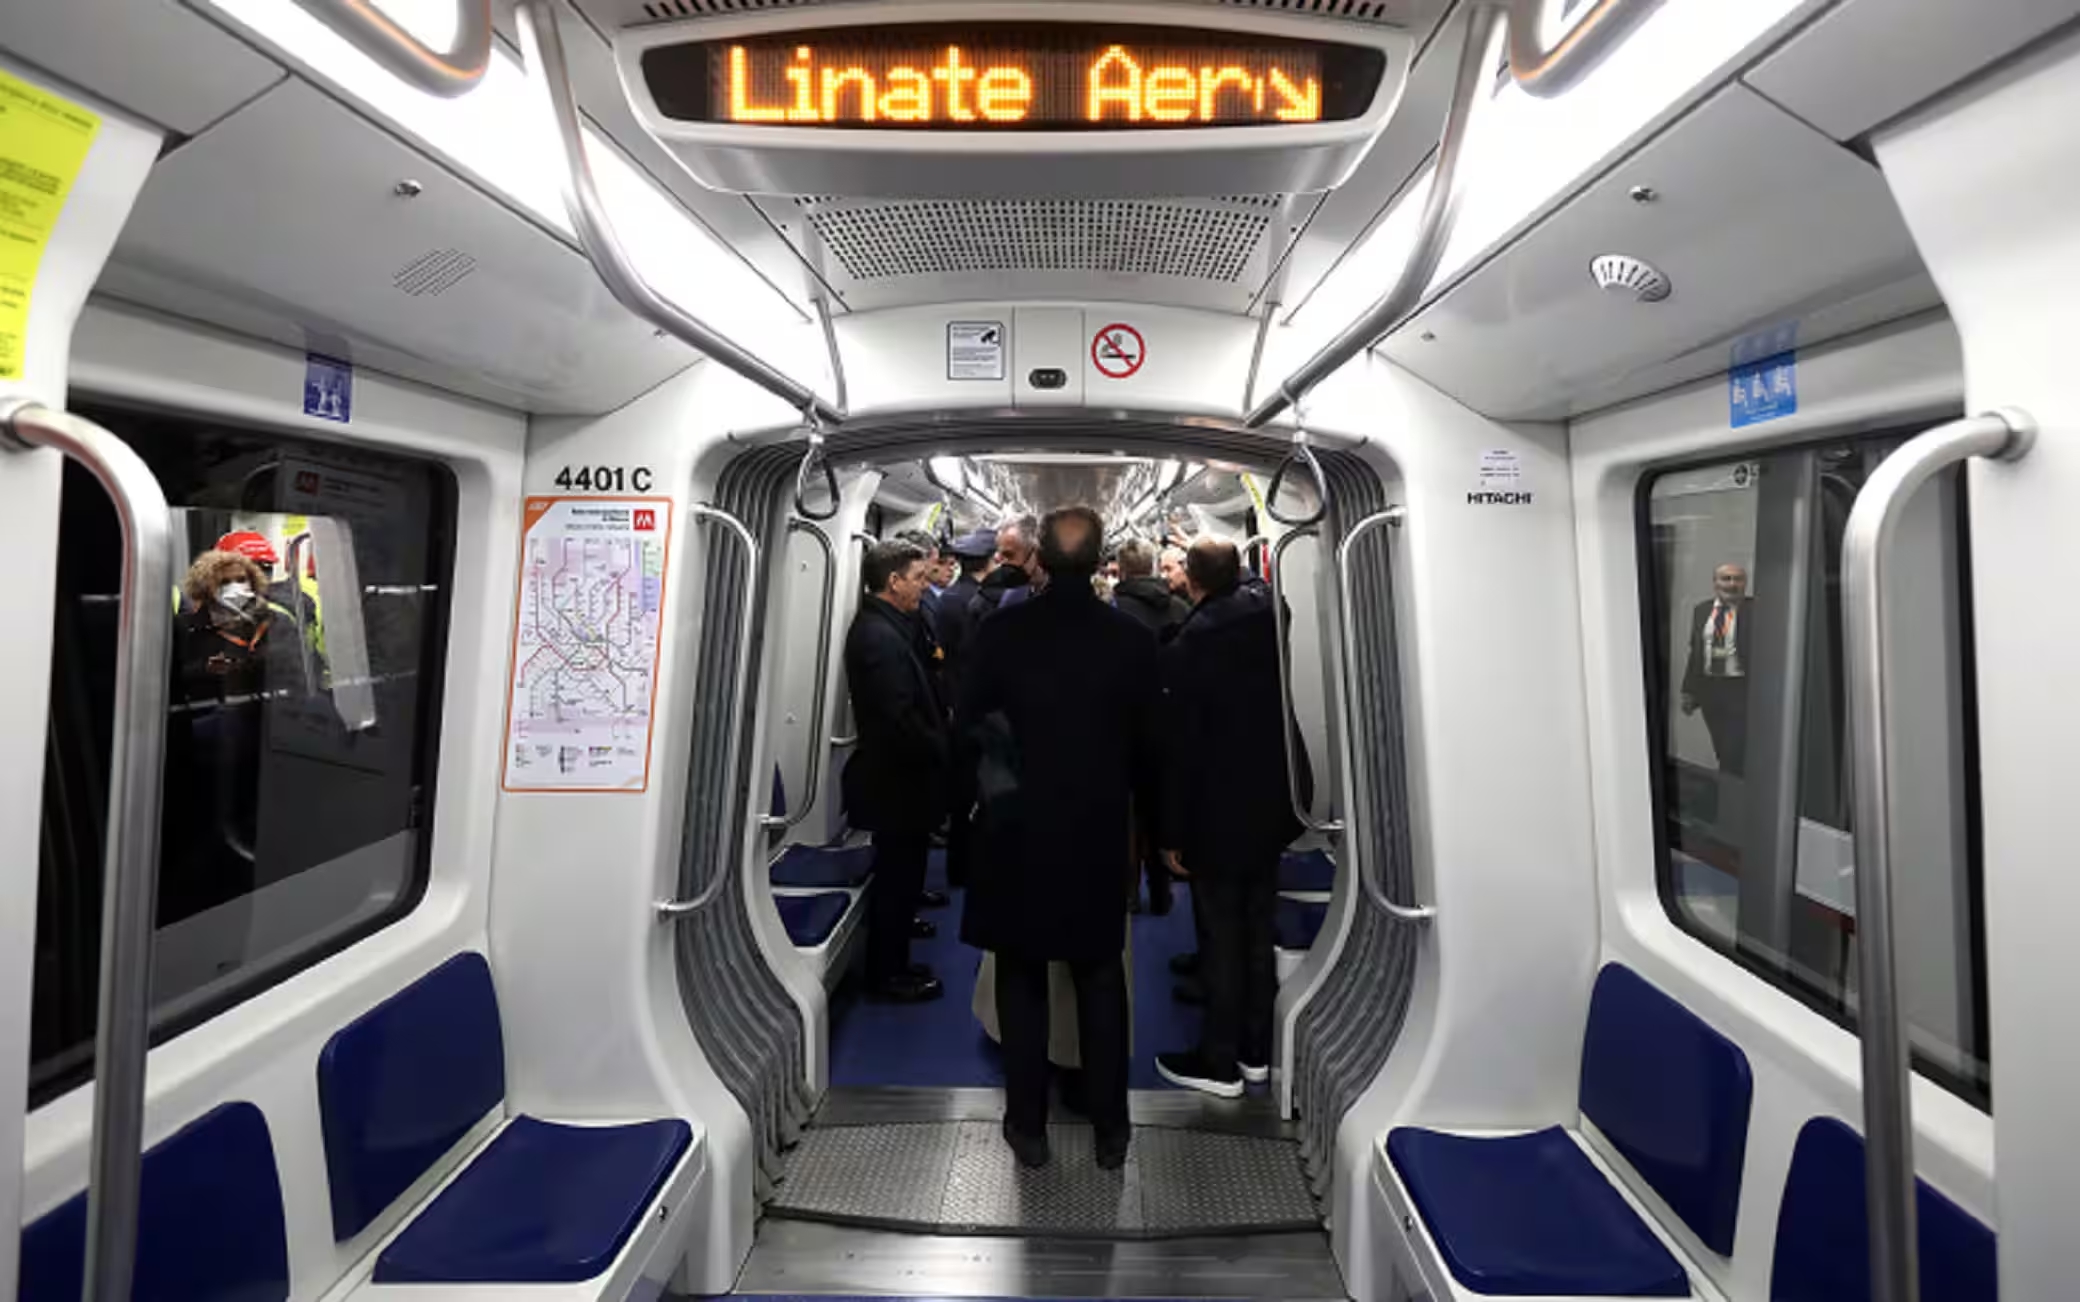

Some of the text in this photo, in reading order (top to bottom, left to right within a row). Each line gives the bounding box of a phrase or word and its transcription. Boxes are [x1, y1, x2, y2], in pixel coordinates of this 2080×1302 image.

[729, 46, 1264, 123] Linate Aer
[554, 467, 652, 492] 4401 C
[1467, 492, 1531, 505] HITACHI
